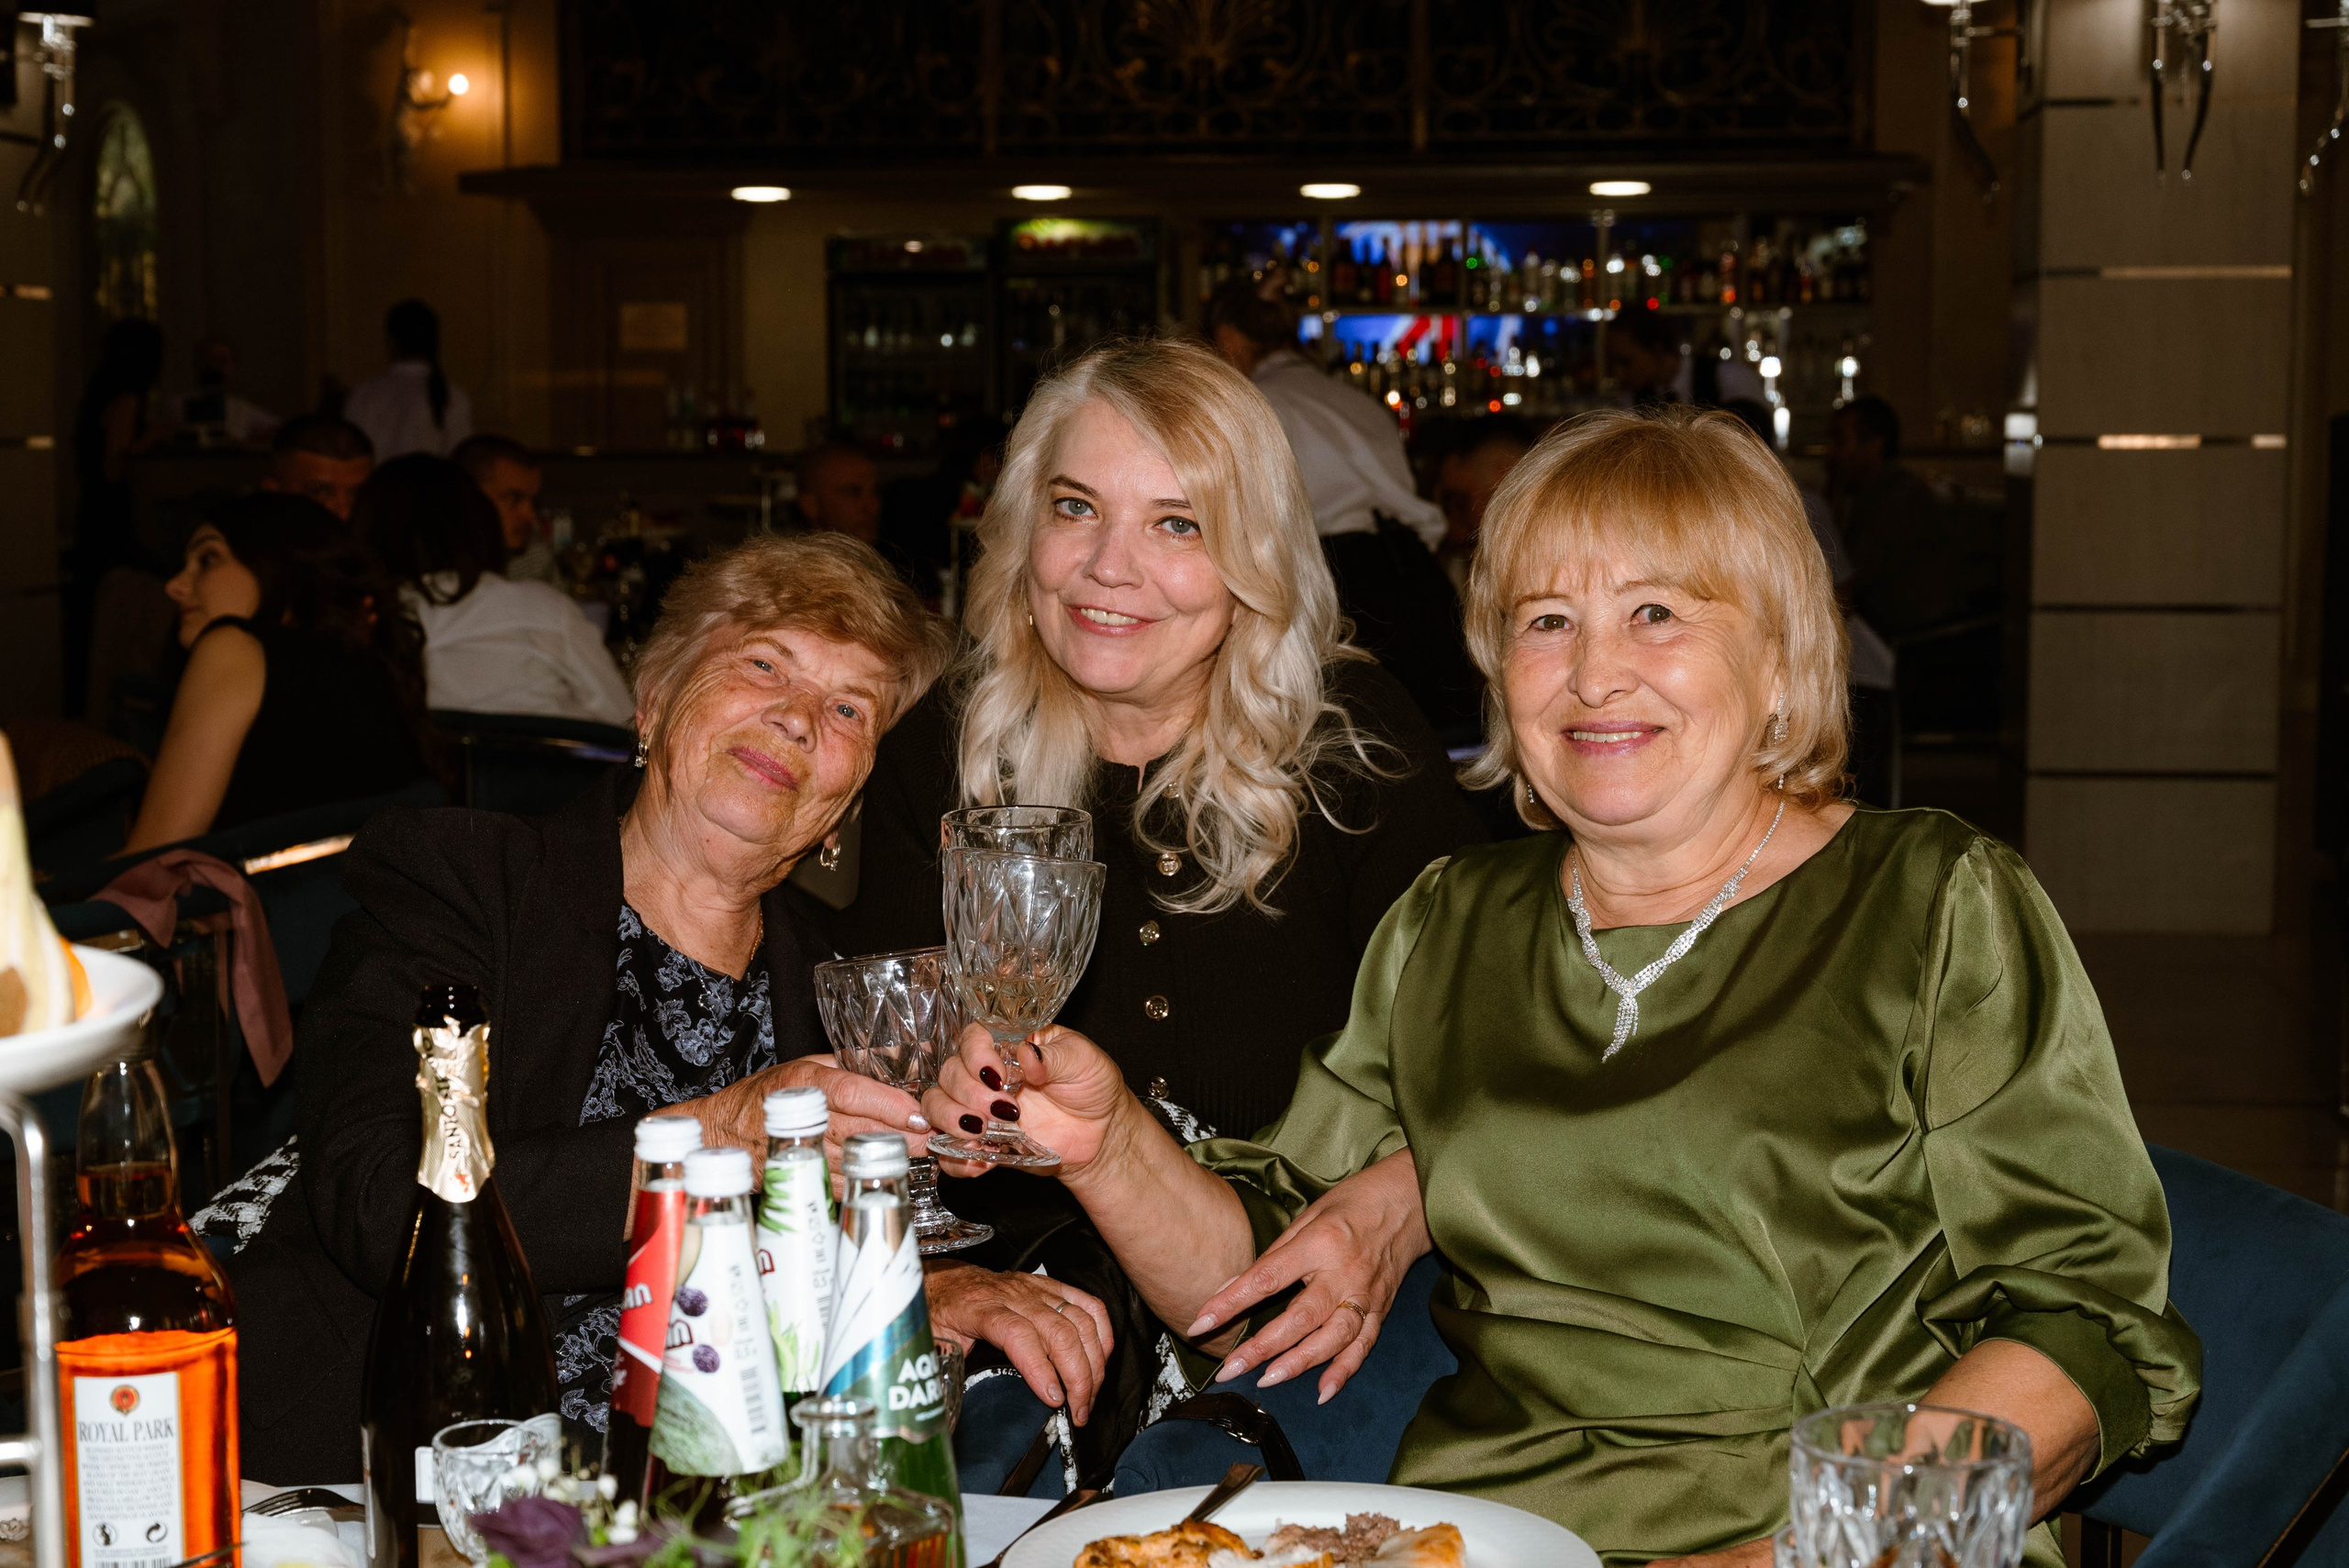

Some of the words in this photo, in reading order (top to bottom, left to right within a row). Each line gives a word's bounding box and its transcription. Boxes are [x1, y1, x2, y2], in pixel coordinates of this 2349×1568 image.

[441, 1104, 462, 1159] SANTO
[888, 1375, 943, 1411] DAR
[78, 1420, 128, 1443] ROYAL
[134, 1417, 174, 1441] PARK
